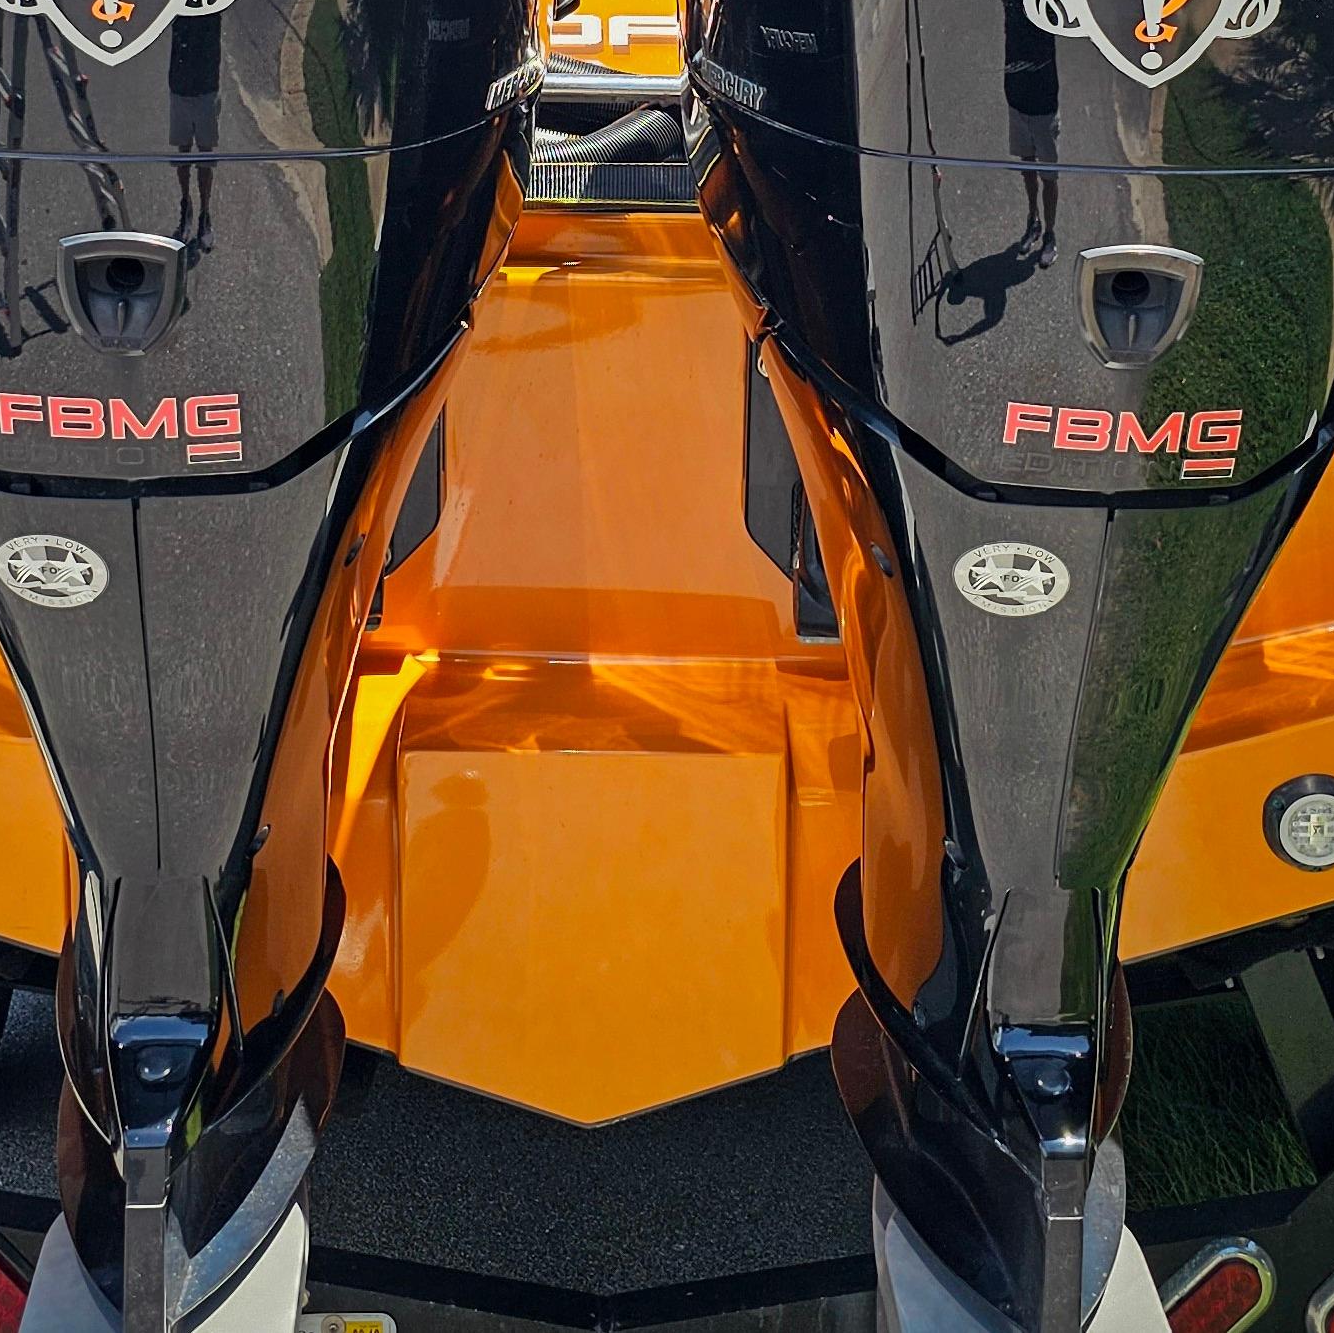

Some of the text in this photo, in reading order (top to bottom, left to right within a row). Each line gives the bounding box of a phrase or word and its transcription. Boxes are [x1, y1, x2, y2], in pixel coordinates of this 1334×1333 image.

[1002, 401, 1243, 453] FBMG
[55, 538, 88, 554] LOW
[973, 545, 1055, 564] VERY LOW
